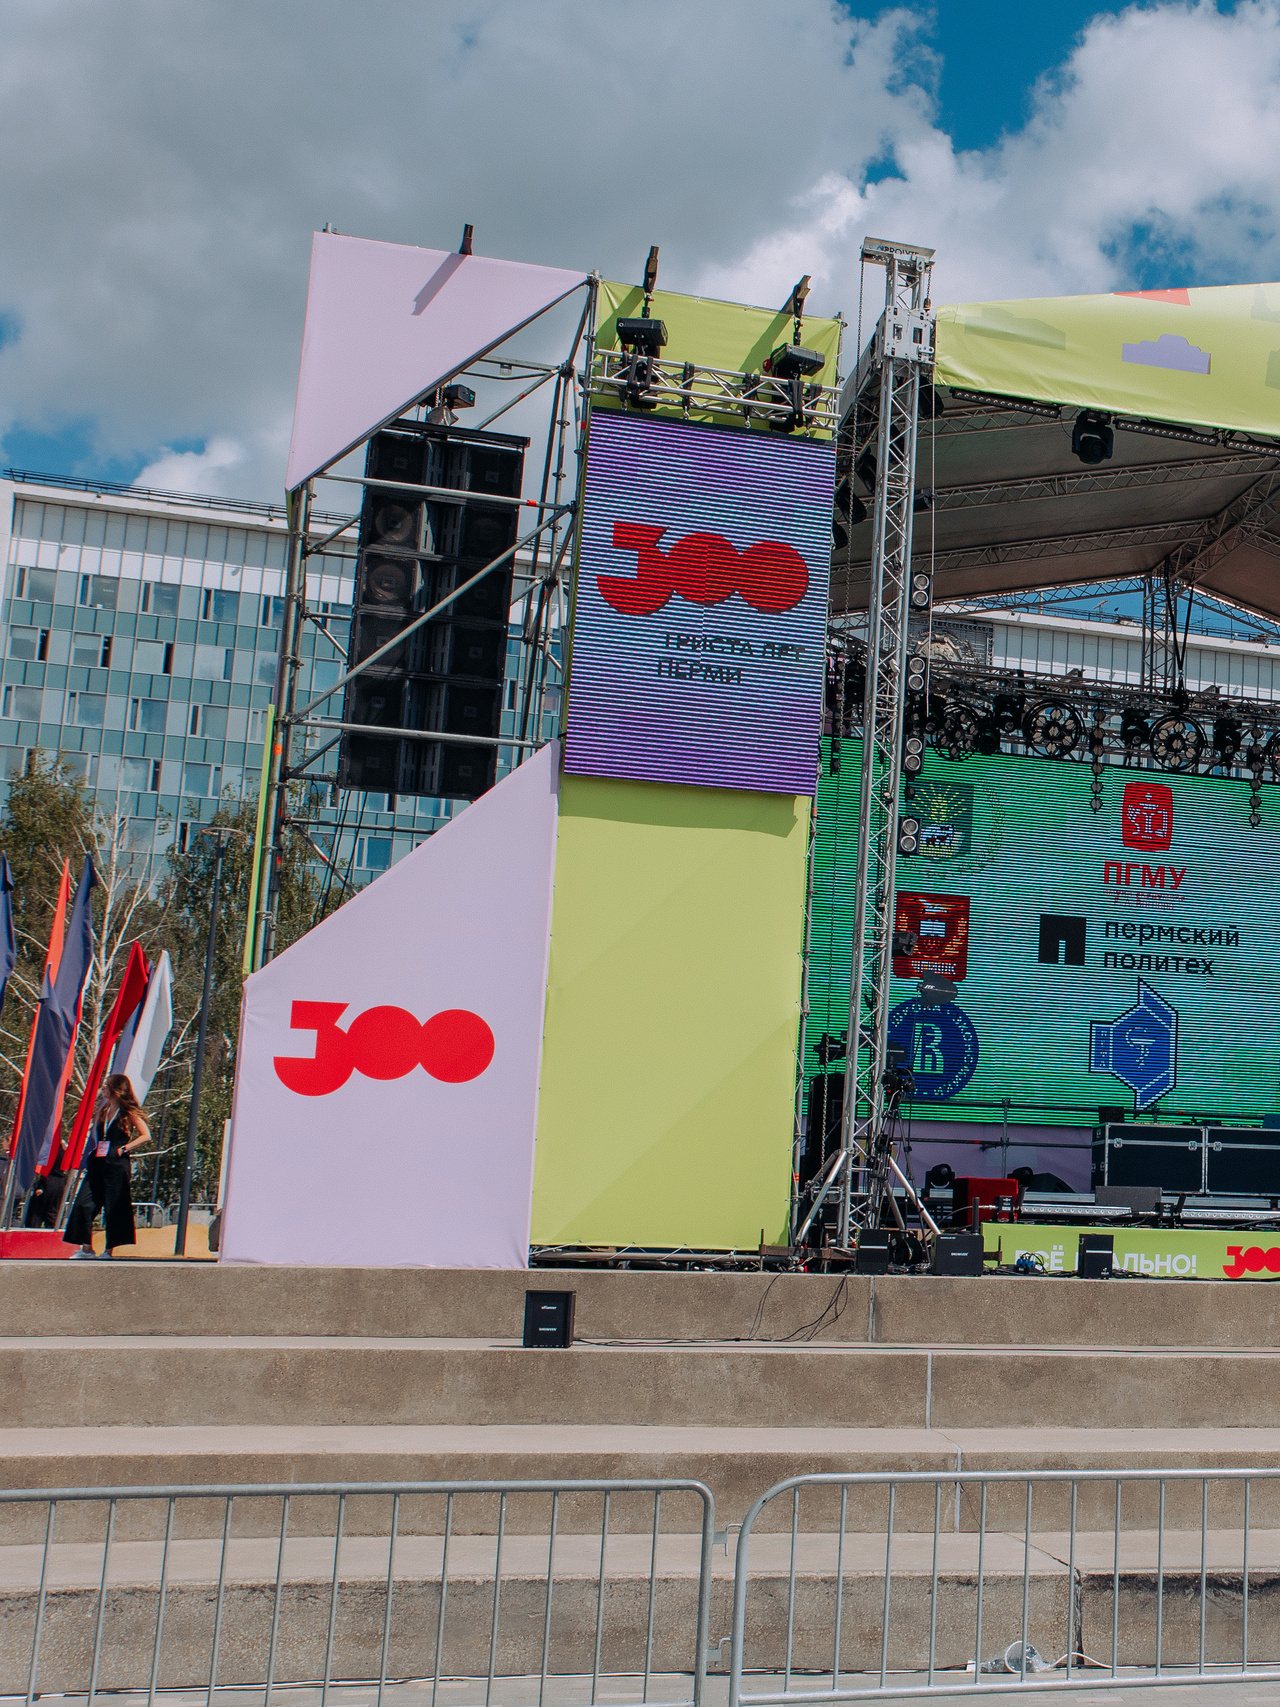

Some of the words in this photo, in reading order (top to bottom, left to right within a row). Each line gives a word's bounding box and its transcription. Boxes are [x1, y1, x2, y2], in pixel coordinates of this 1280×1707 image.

[597, 522, 809, 616] 300
[1103, 860, 1187, 889] ПГМУ
[1105, 921, 1239, 946] пермский
[1104, 952, 1214, 975] политех
[273, 1000, 495, 1096] 300
[1075, 1252, 1197, 1274] АЛЬНО!
